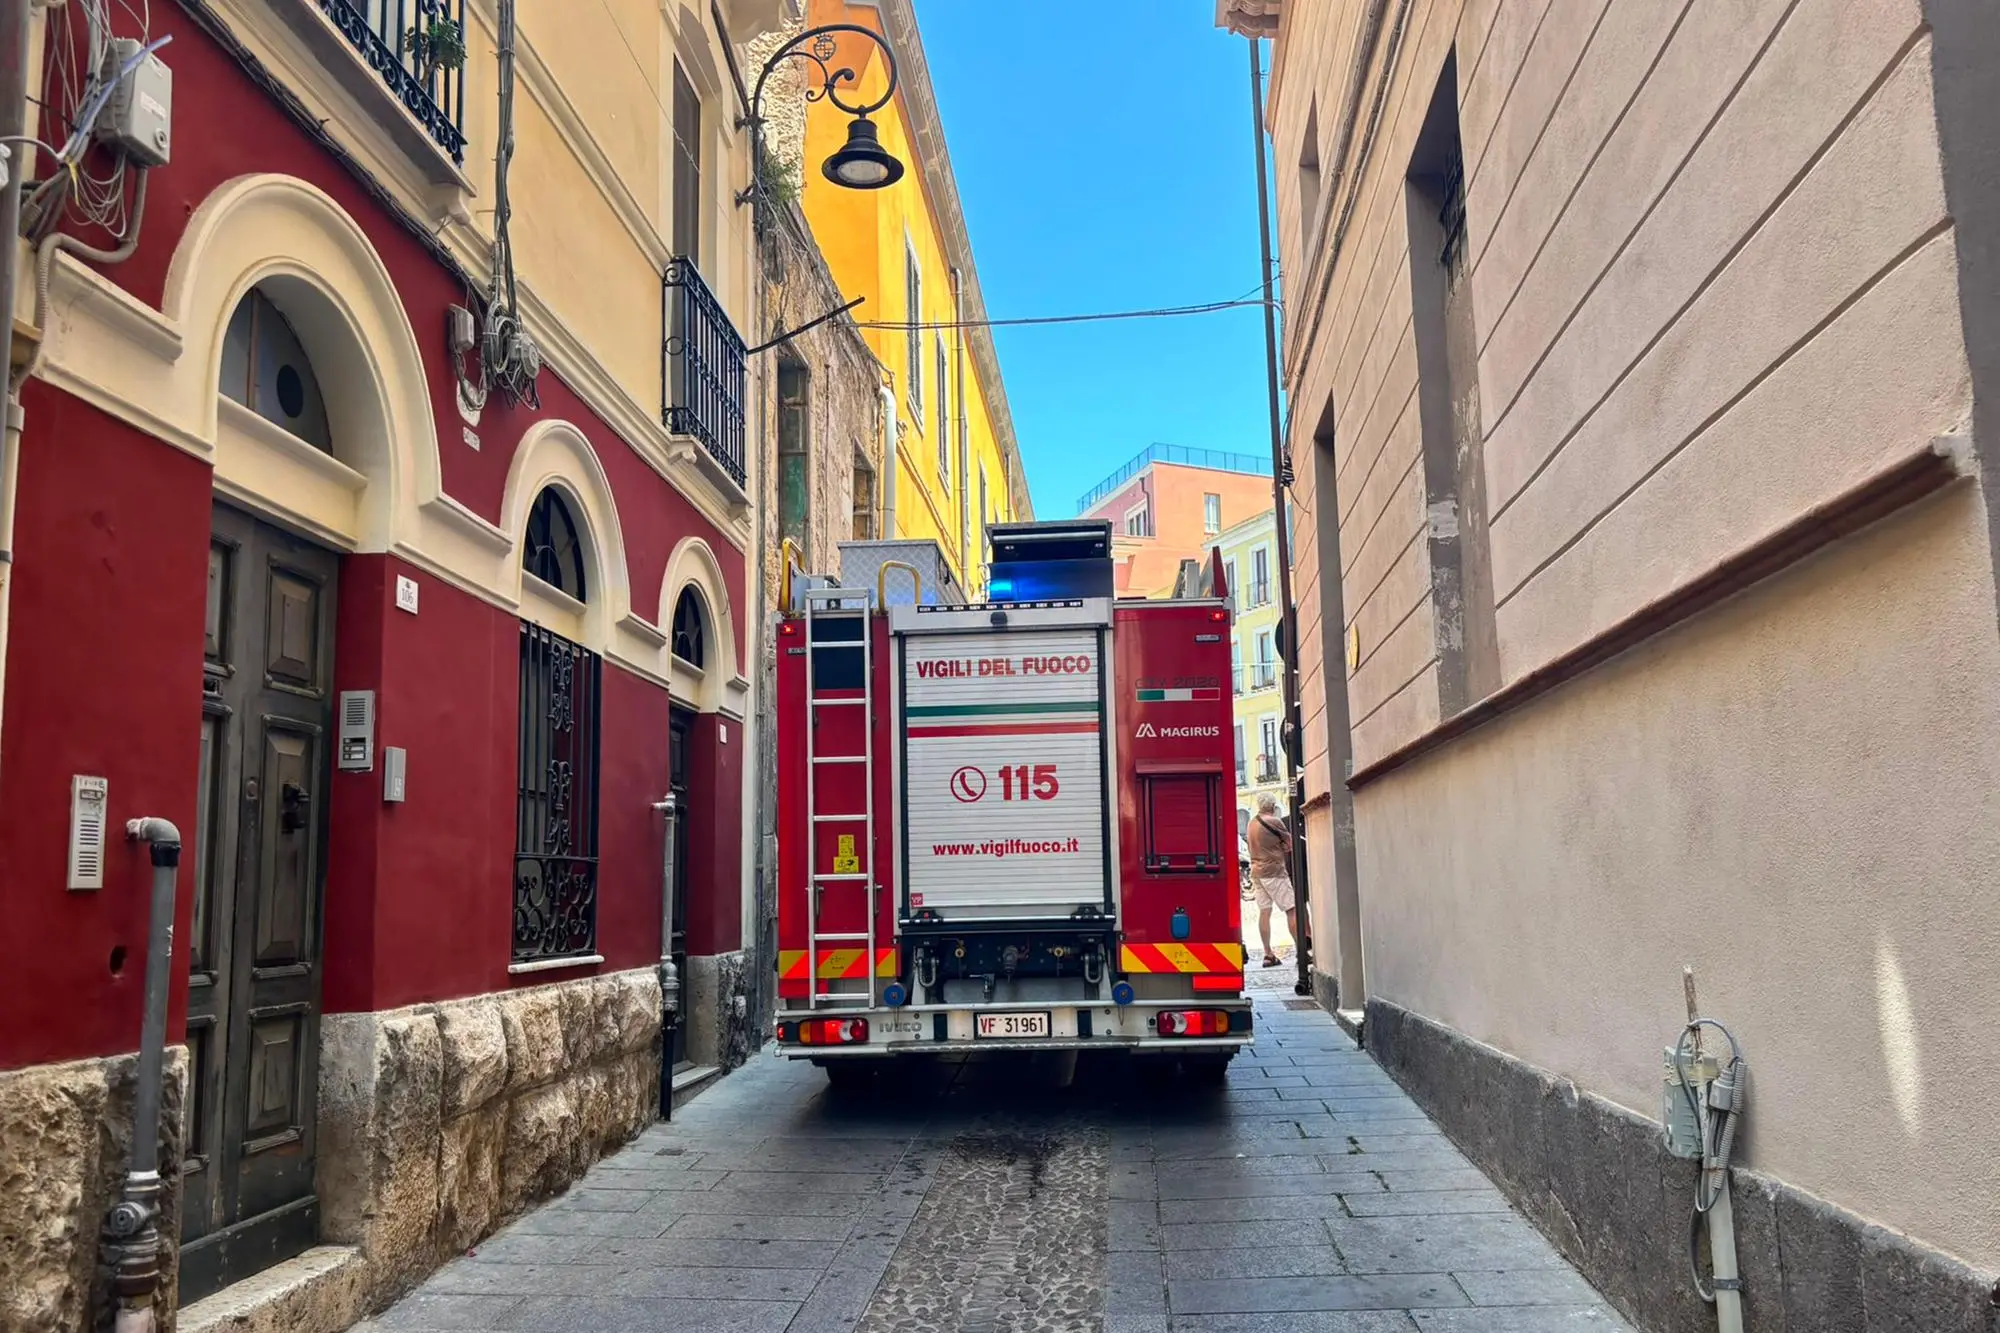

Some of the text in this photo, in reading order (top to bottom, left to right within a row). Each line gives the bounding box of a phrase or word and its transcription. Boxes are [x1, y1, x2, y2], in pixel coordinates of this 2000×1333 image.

[402, 588, 414, 604] 106
[917, 656, 1091, 678] VIGILI DEL FUOCO
[1160, 726, 1220, 737] MAGIRUS
[999, 764, 1060, 801] 115
[933, 838, 1079, 857] www.vigilfuoco.it
[980, 1017, 1043, 1033] VF 31961
